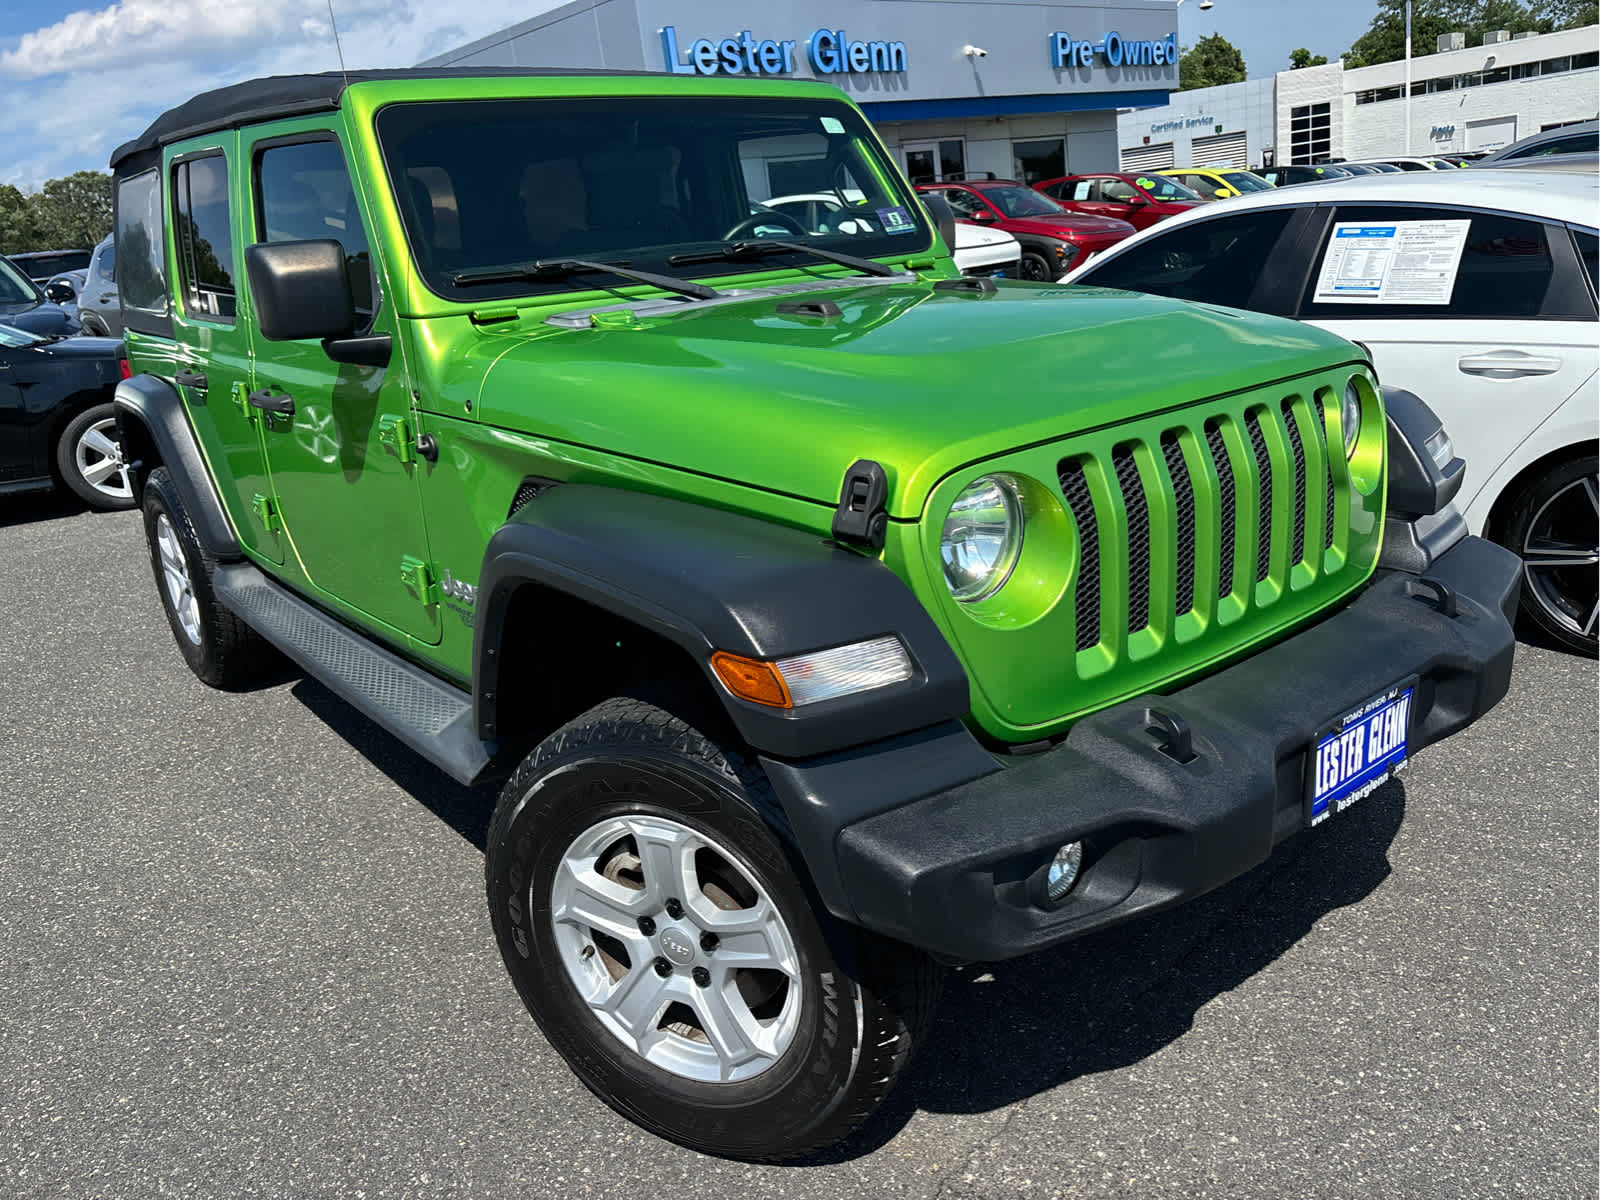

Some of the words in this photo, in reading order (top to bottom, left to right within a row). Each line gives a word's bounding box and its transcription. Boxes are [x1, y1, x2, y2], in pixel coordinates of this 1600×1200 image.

[661, 25, 796, 75] Lester
[807, 28, 908, 74] Glenn
[1050, 31, 1177, 67] Pre-Owned
[1151, 120, 1183, 132] Certified
[1186, 116, 1214, 128] Service
[1342, 708, 1364, 726] TOMS
[1387, 687, 1399, 701] NJ
[1315, 724, 1365, 798] LESTER
[1367, 697, 1409, 764] GLENN
